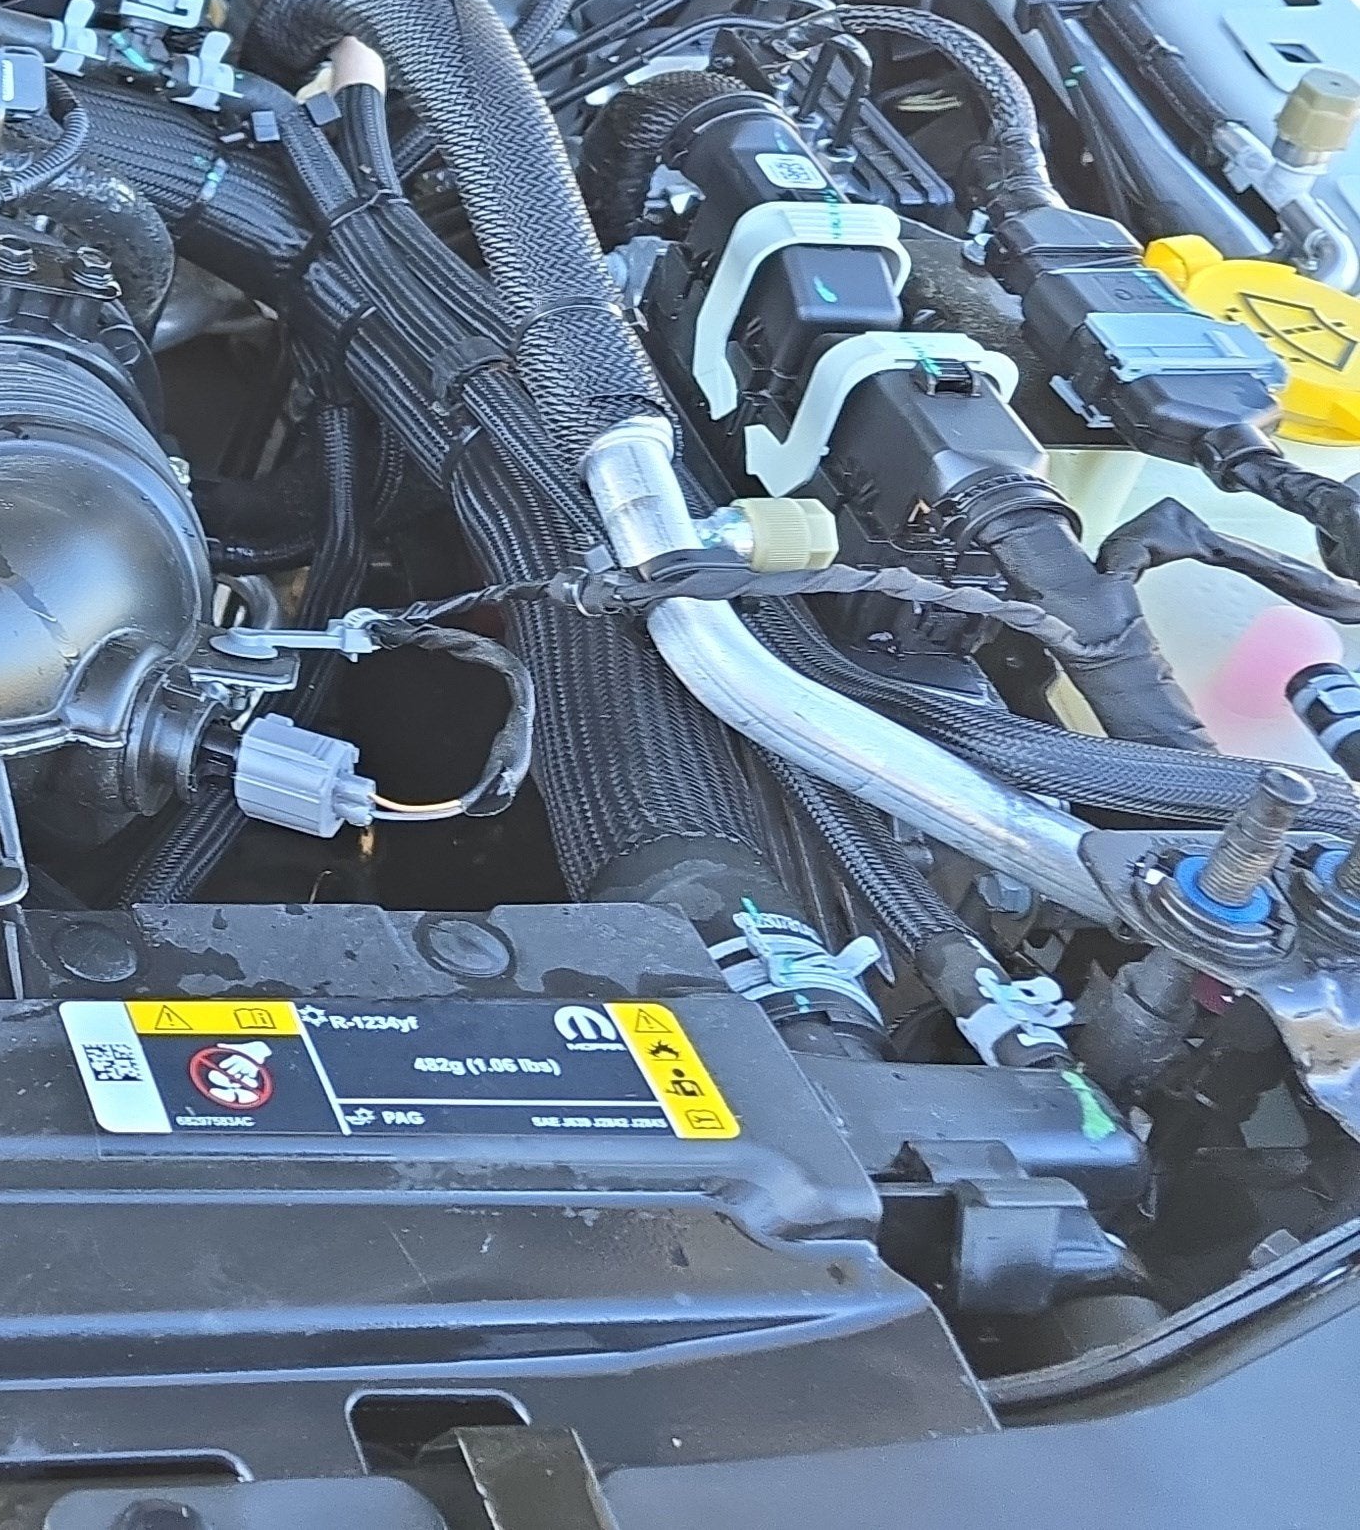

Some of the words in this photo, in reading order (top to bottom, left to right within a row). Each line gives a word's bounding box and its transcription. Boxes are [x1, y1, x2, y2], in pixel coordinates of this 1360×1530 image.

[328, 1015, 420, 1033] R-1234yf
[414, 1057, 467, 1075] 482g
[466, 1057, 519, 1075] (1.06
[517, 1057, 562, 1076] lbs)
[381, 1110, 426, 1125] PAG
